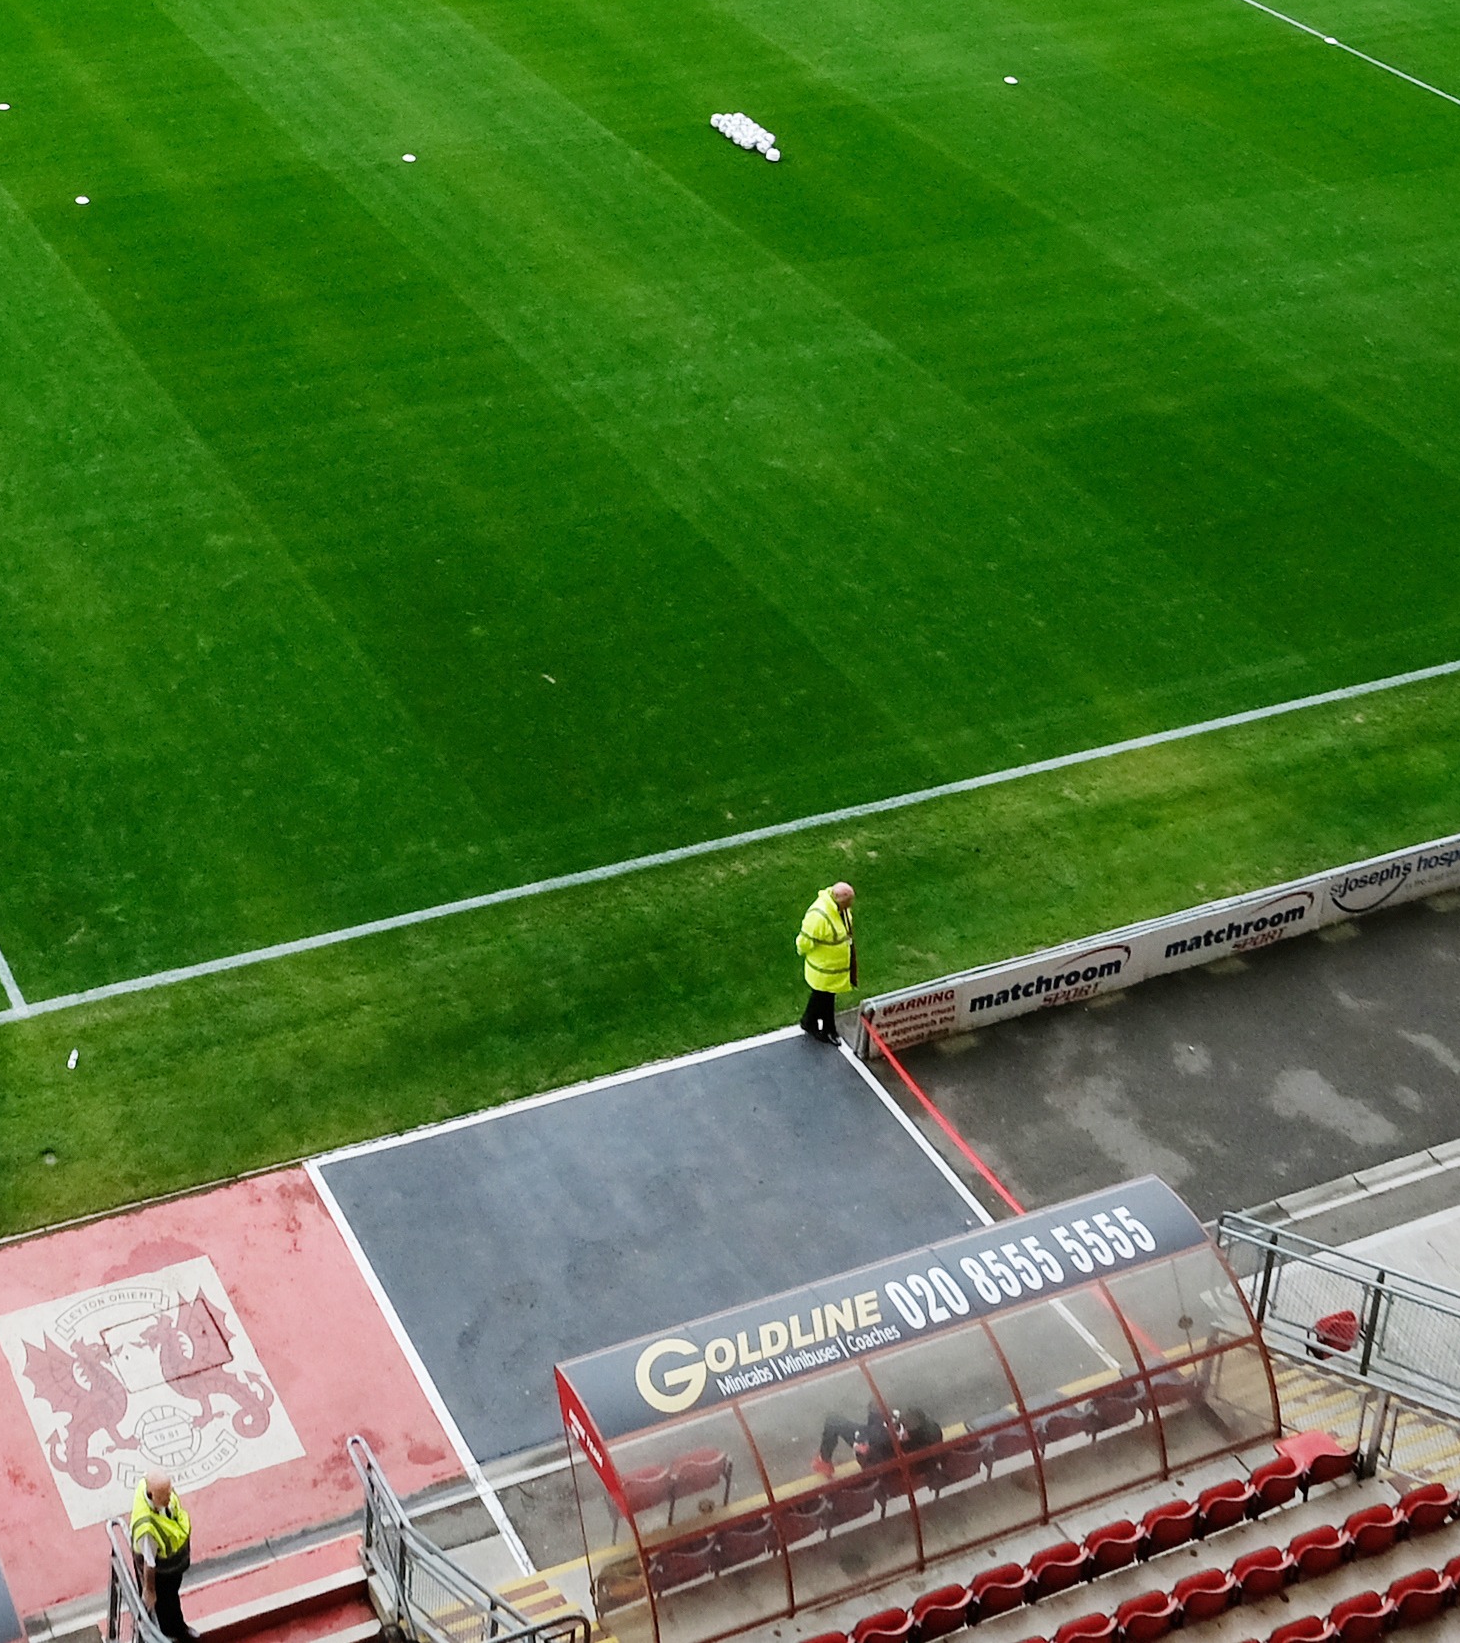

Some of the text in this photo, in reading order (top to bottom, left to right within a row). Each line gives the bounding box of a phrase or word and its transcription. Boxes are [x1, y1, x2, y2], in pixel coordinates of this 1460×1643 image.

[1164, 904, 1306, 959] matchroom
[1230, 927, 1286, 952] SPORT
[882, 989, 956, 1017] WARNING
[969, 958, 1122, 1013] matchroom
[1041, 981, 1101, 1008] SPORT
[62, 1290, 155, 1327] LEYTON ORIENT
[633, 1204, 1158, 1414] GOLDLINE 020 8555 5555
[714, 1323, 902, 1398] Minicabs Minibuses Coaches
[199, 1447, 230, 1472] CLUB
